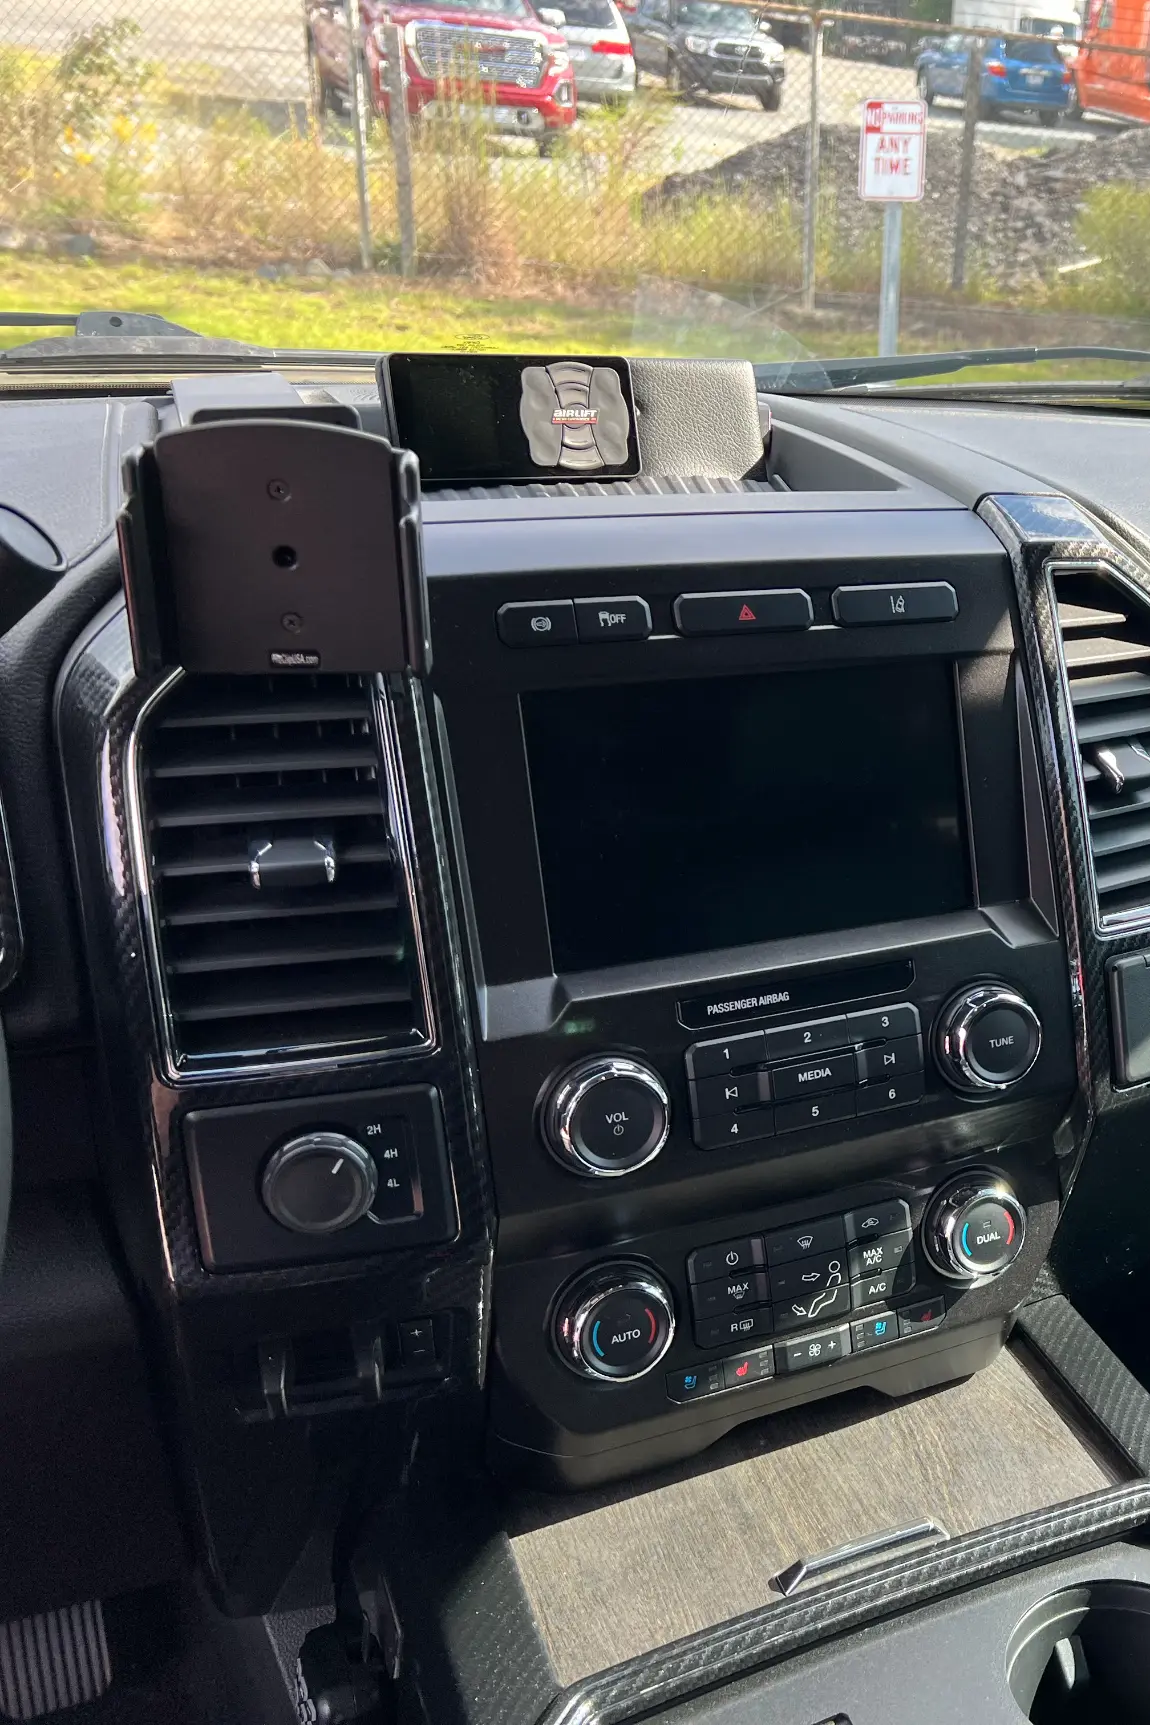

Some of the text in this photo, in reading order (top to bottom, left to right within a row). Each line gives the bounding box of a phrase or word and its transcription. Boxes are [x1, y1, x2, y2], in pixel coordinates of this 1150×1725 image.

[875, 136, 912, 153] ANY
[873, 156, 912, 175] TIME
[609, 613, 626, 624] OFF
[706, 991, 790, 1016] PASSENGER AIRBAG
[881, 1016, 890, 1027] 3
[803, 1031, 812, 1043] 2
[989, 1035, 1015, 1049] TUNE
[723, 1048, 730, 1060] 1
[798, 1067, 832, 1083] MEDIA
[888, 1089, 896, 1100] 6
[605, 1111, 629, 1124] VOL
[811, 1106, 820, 1117] 5
[366, 1123, 382, 1135] 2H
[730, 1123, 739, 1134] 4
[383, 1147, 399, 1159] 4H
[387, 1177, 400, 1188] 4L
[976, 1231, 1001, 1245] DUAL
[863, 1246, 884, 1259] MAX
[866, 1253, 883, 1266] A/C
[727, 1281, 749, 1295] MAX
[868, 1282, 887, 1295] A/C
[730, 1323, 739, 1333] R
[611, 1329, 641, 1345] AUTO
